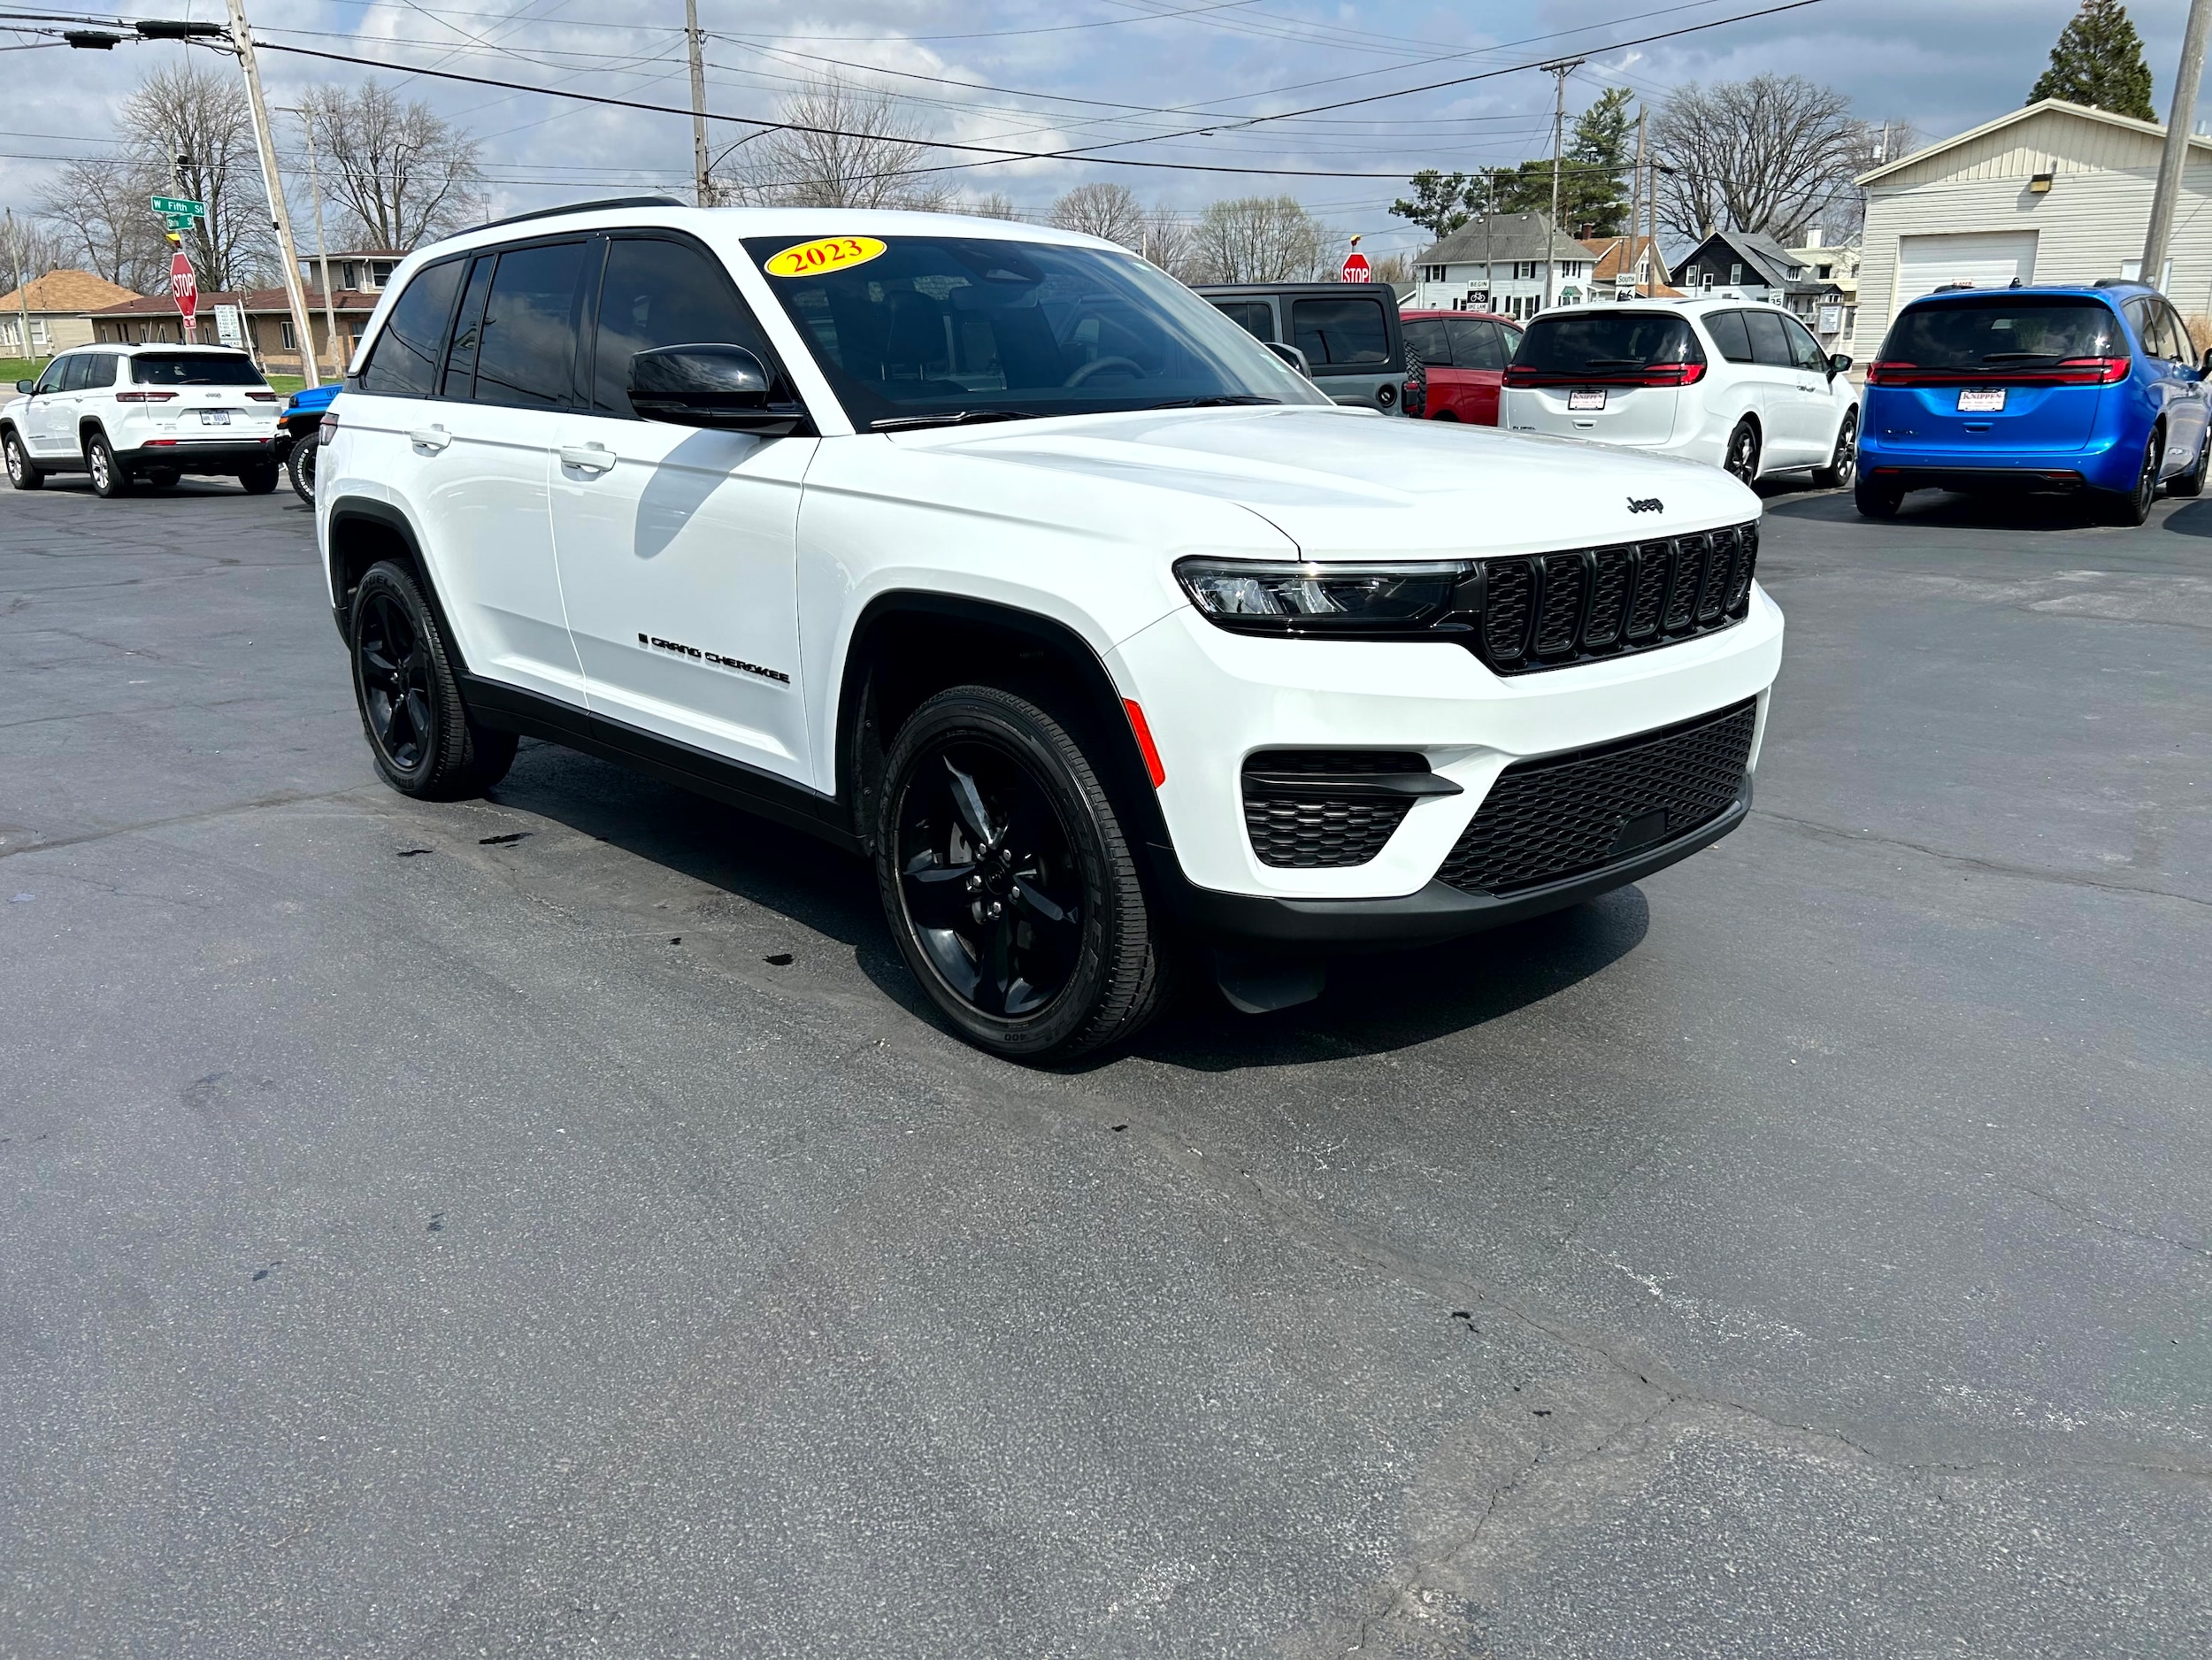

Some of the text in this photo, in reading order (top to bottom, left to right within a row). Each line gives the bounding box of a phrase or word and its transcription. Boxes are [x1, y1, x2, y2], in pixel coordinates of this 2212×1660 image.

[153, 199, 204, 214] W Fifth St
[786, 239, 863, 273] 2023
[173, 273, 194, 298] STOP
[1344, 267, 1370, 283] STOP
[1626, 496, 1664, 514] Jeep
[651, 636, 791, 684] GRAND CHEROKEE
